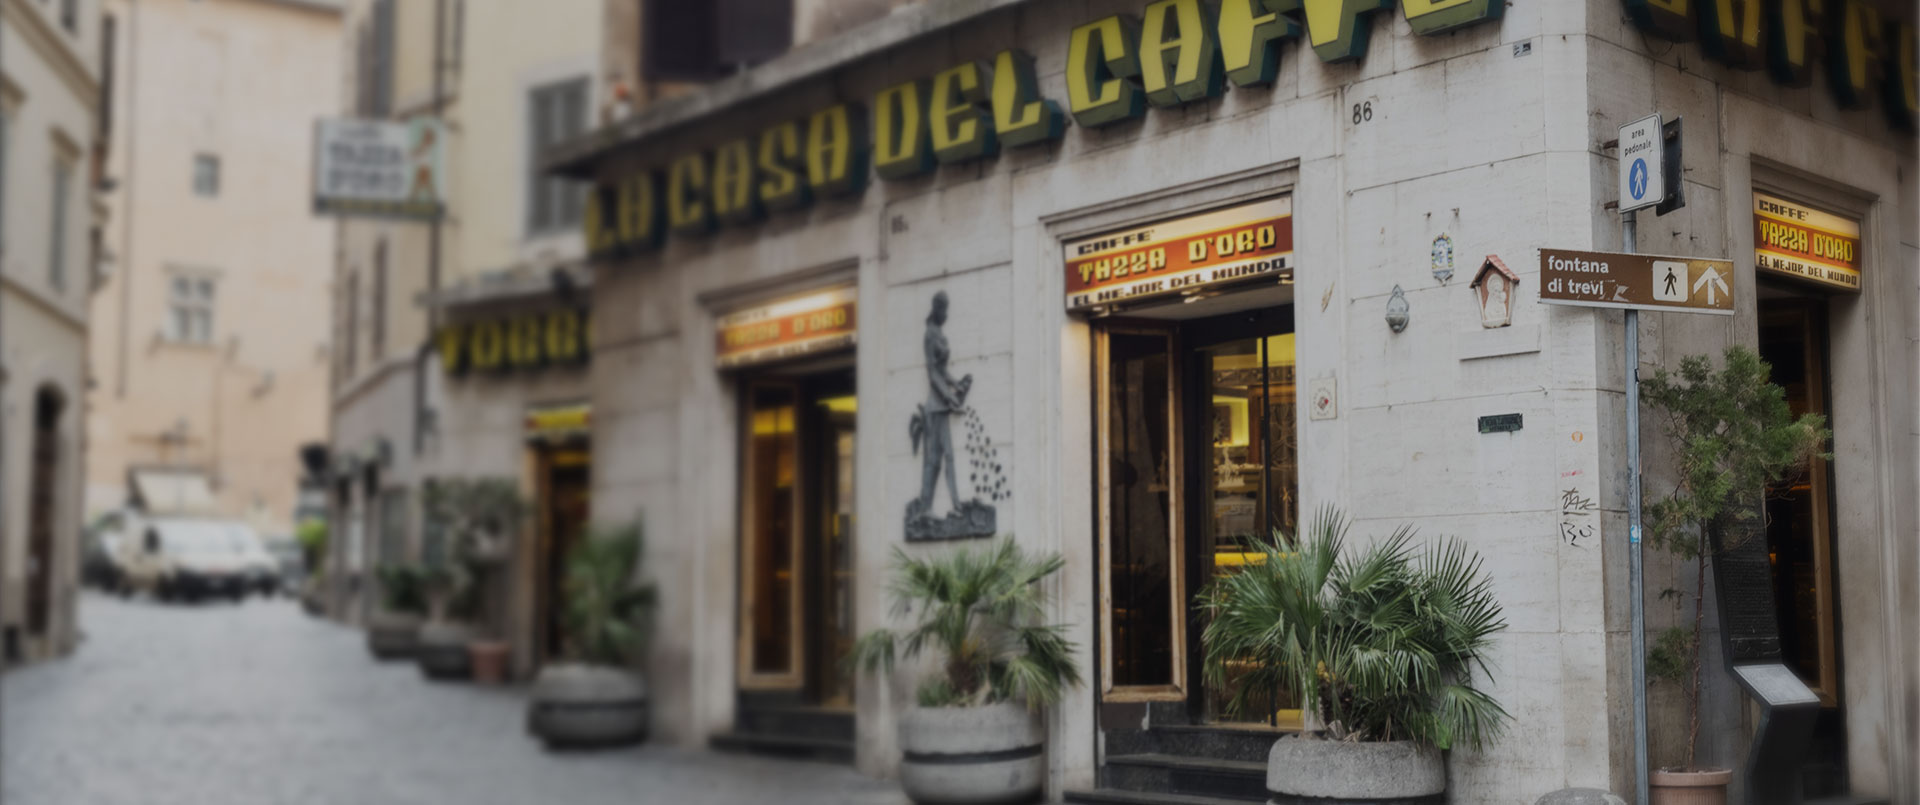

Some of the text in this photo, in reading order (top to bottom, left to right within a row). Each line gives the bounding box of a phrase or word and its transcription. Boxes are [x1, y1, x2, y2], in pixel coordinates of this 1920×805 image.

[1353, 101, 1372, 125] 86
[1631, 128, 1645, 139] area
[585, 172, 653, 256] LA
[667, 104, 850, 229] CASA
[874, 49, 1042, 167] DEL
[1624, 140, 1651, 157] pedonale
[1079, 225, 1275, 284] TAZZA D'ORO
[1760, 220, 1853, 263] TAZZA D'ORO
[1548, 255, 1608, 273] fontana
[1759, 255, 1857, 286] EL MEJOR DEL MUNDO
[1073, 257, 1285, 306] EL MEJOR DEL MUNDO
[1548, 278, 1604, 295] di trevi
